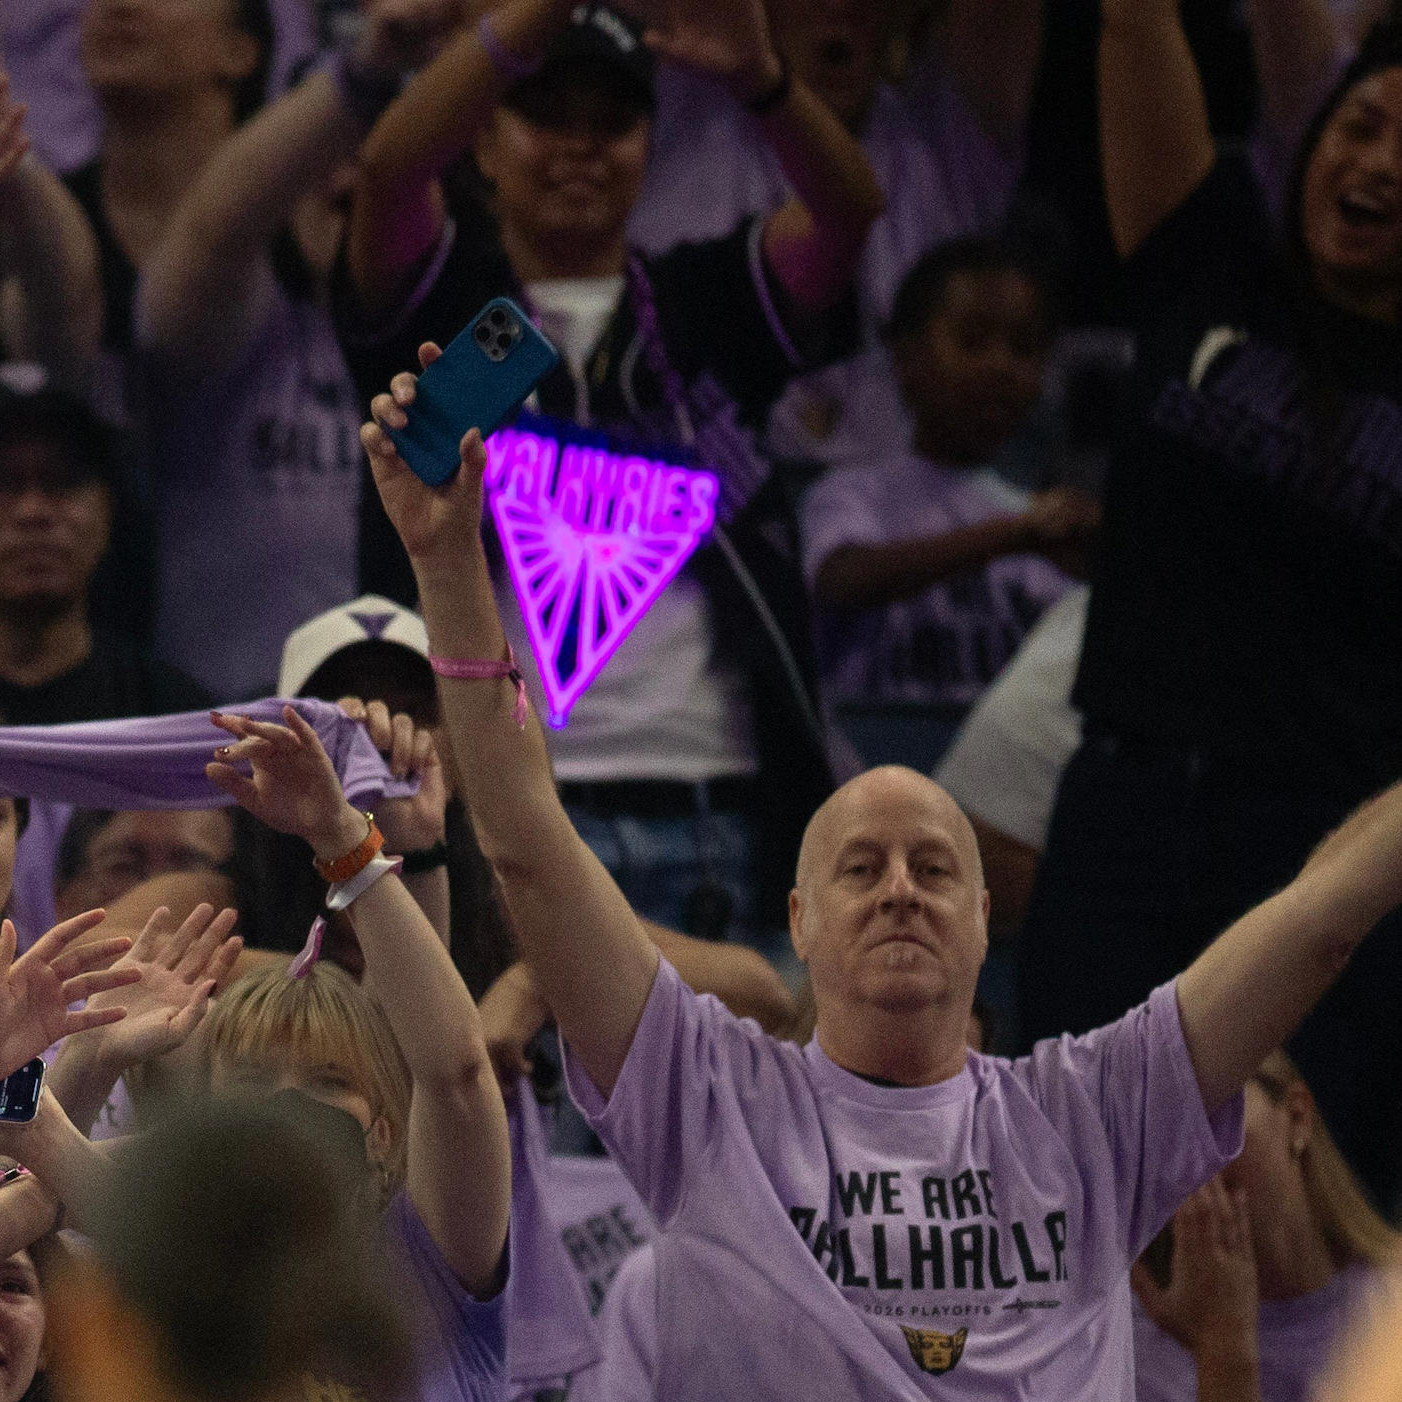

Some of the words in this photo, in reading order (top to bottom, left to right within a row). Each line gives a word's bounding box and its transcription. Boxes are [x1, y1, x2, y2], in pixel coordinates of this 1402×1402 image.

[836, 1170, 904, 1218] WE
[922, 1168, 998, 1220] ARE
[910, 1303, 993, 1317] PLAYOFFS
